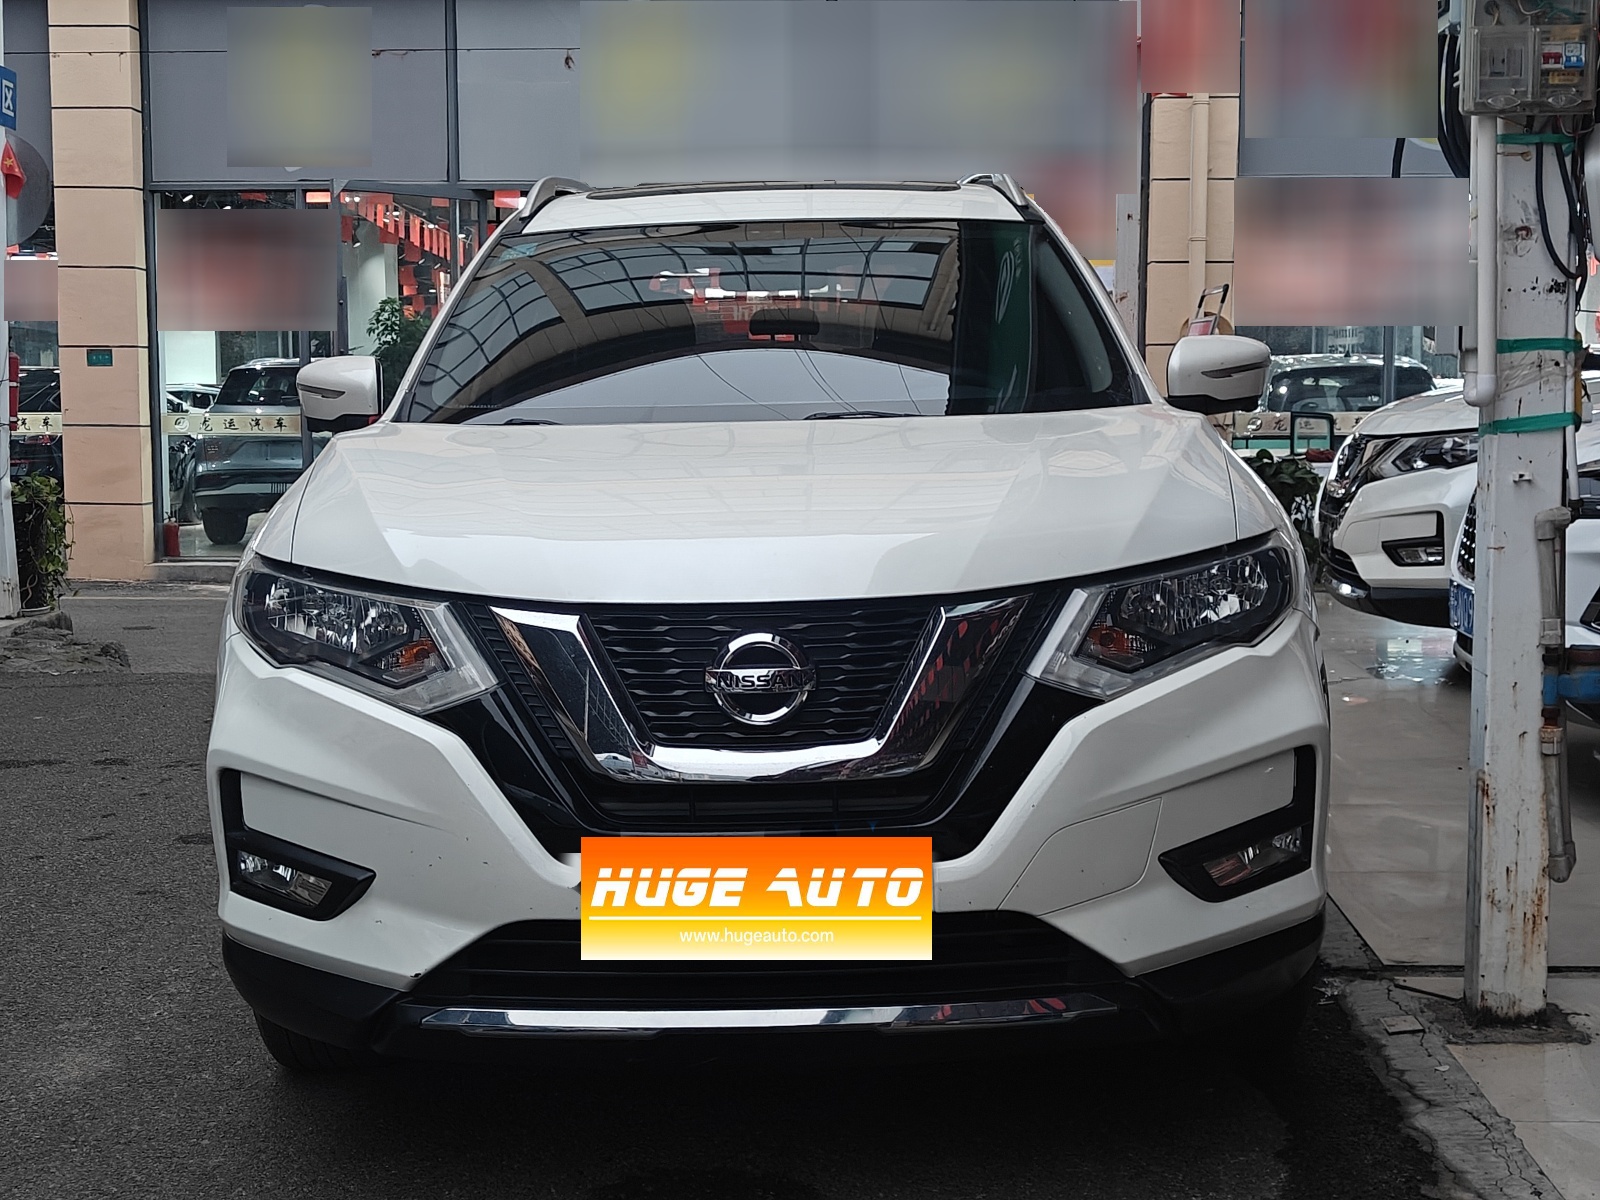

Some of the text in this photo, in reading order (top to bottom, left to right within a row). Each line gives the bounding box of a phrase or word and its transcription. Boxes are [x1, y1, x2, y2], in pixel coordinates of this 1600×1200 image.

[199, 417, 287, 432] 龙运汽车
[717, 674, 804, 689] NISSAN
